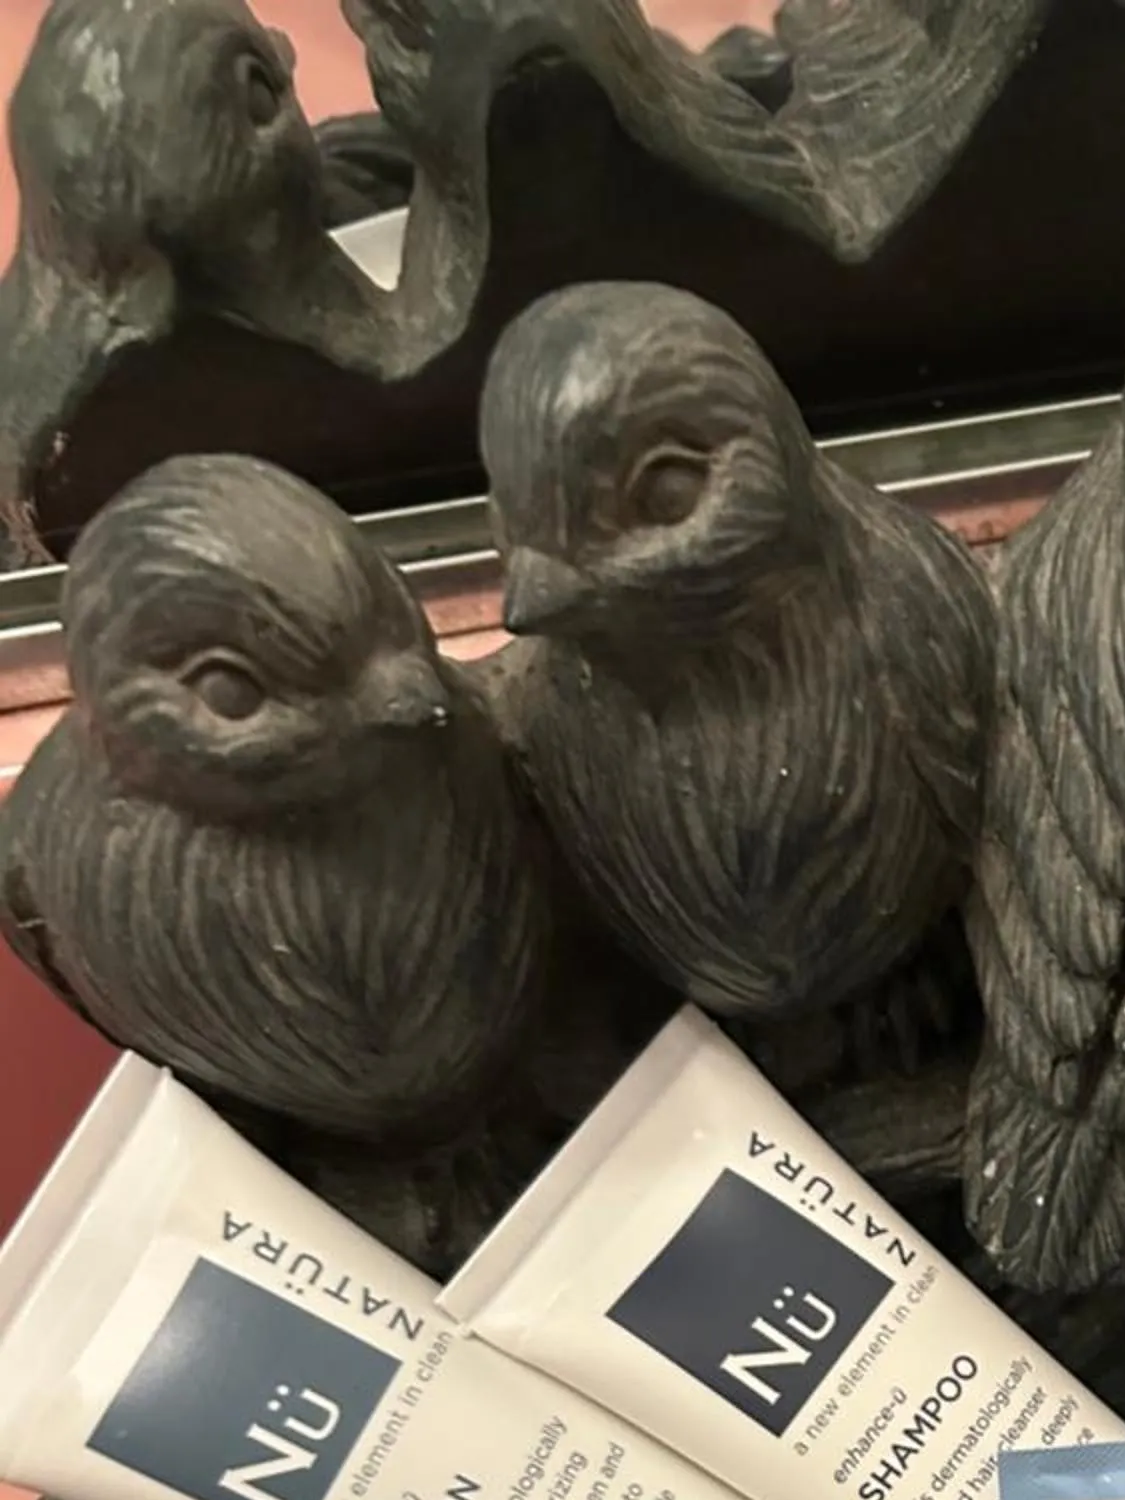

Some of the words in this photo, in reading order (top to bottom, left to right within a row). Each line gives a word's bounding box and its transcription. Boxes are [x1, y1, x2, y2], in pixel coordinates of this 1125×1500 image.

[748, 1130, 917, 1267] NATÜRA
[221, 1211, 424, 1341] NATÜRA
[720, 1285, 836, 1406] Nü
[794, 1442, 810, 1456] a
[804, 1400, 840, 1440] new
[839, 1323, 897, 1395] element
[892, 1303, 911, 1324] in
[350, 1410, 411, 1497] element
[400, 1385, 422, 1408] in
[418, 1331, 454, 1382] clean
[600, 1441, 625, 1479] and
[931, 1355, 1034, 1494] dermatologically
[1041, 1394, 1079, 1446] deeply
